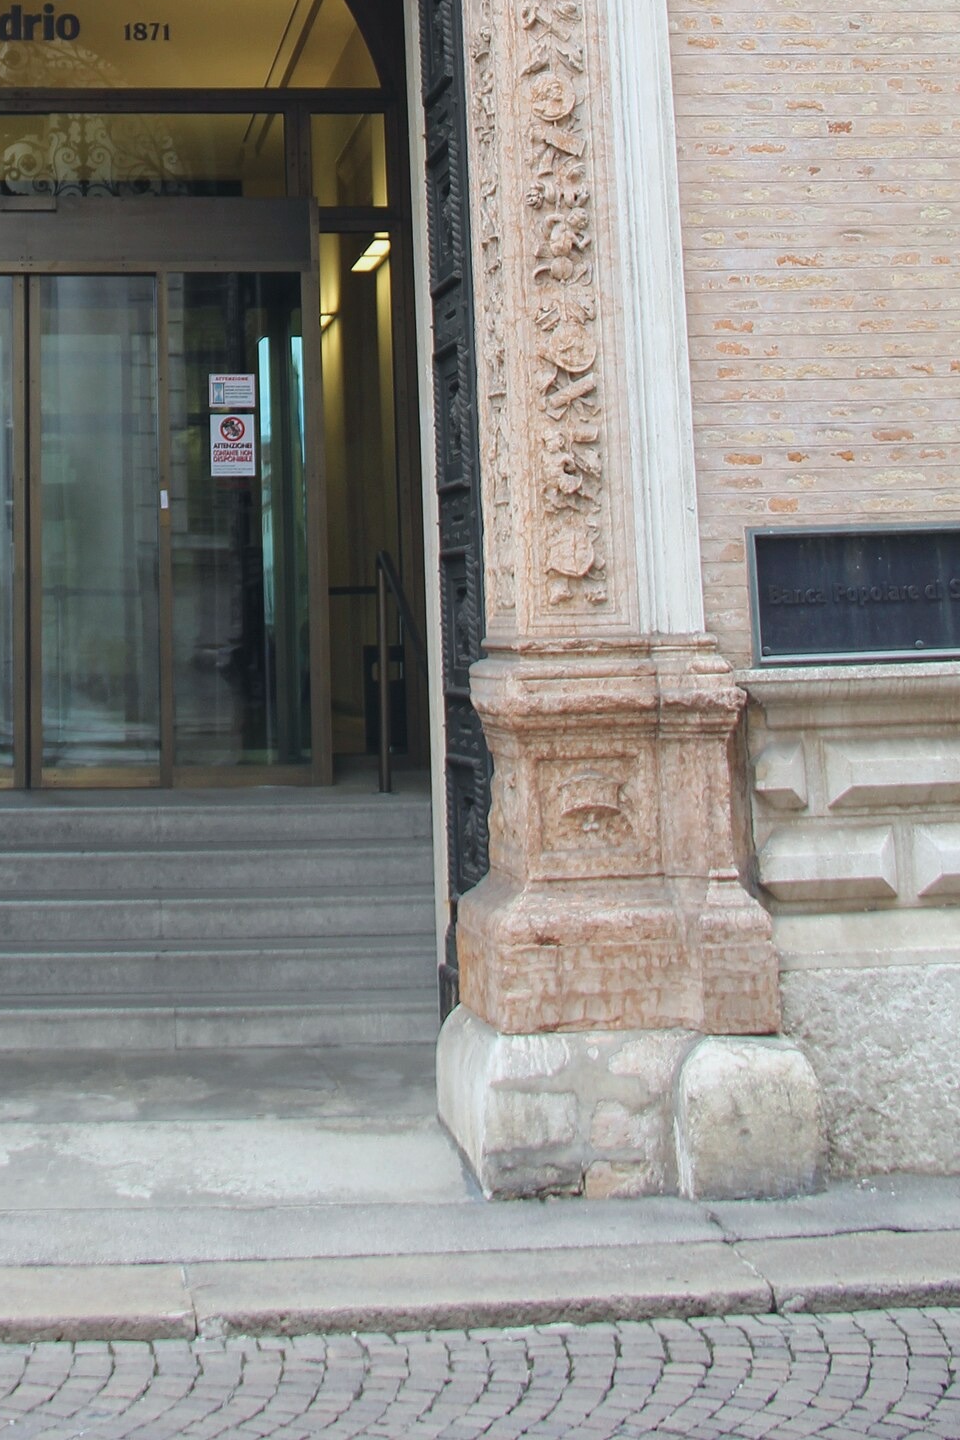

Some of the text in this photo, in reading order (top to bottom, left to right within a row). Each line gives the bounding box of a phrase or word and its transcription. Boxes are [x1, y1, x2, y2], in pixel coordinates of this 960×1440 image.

[123, 22, 171, 42] 1871
[768, 584, 826, 604] Banca
[832, 580, 920, 606] Popolare
[925, 579, 942, 601] di
